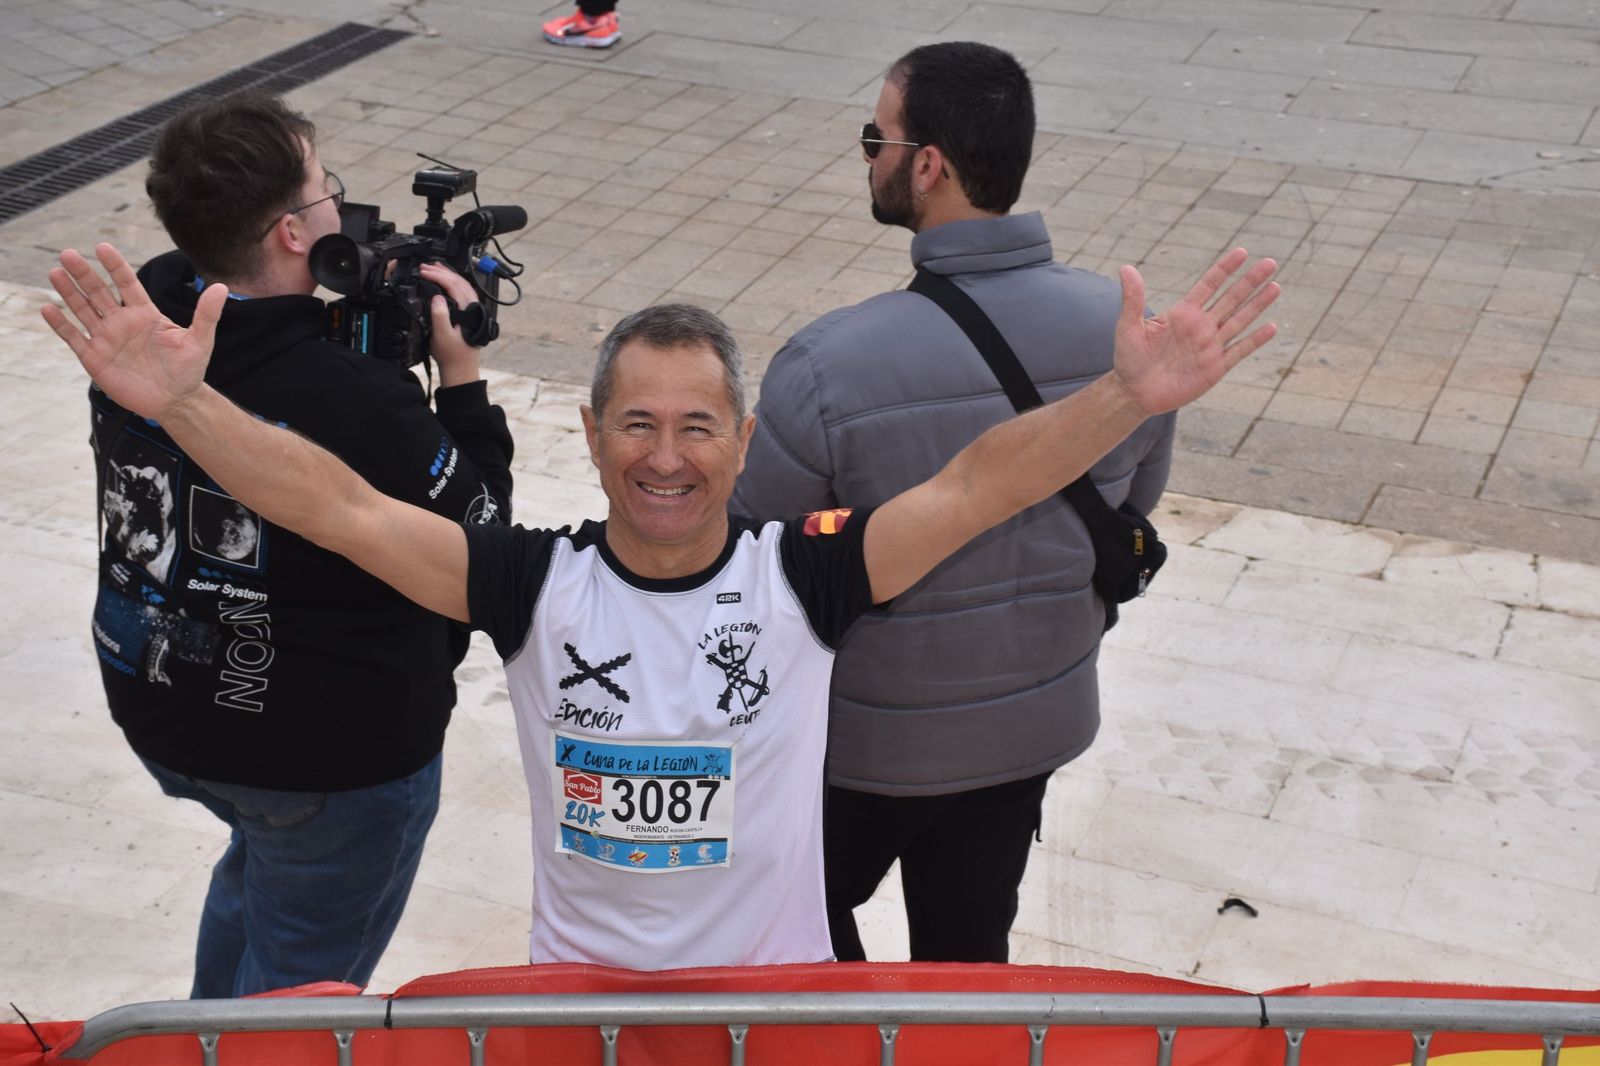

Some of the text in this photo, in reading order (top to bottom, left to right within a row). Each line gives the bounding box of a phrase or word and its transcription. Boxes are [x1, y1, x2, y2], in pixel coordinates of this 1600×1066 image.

[428, 475, 448, 500] Solar
[187, 578, 268, 602] Solar System
[697, 633, 713, 650] LA
[729, 709, 761, 727] CEUT
[560, 743, 576, 762] X
[564, 779, 602, 794] San Pablo
[611, 778, 721, 824] 3087
[565, 800, 606, 828] 20K
[626, 824, 669, 833] FERNANDO
